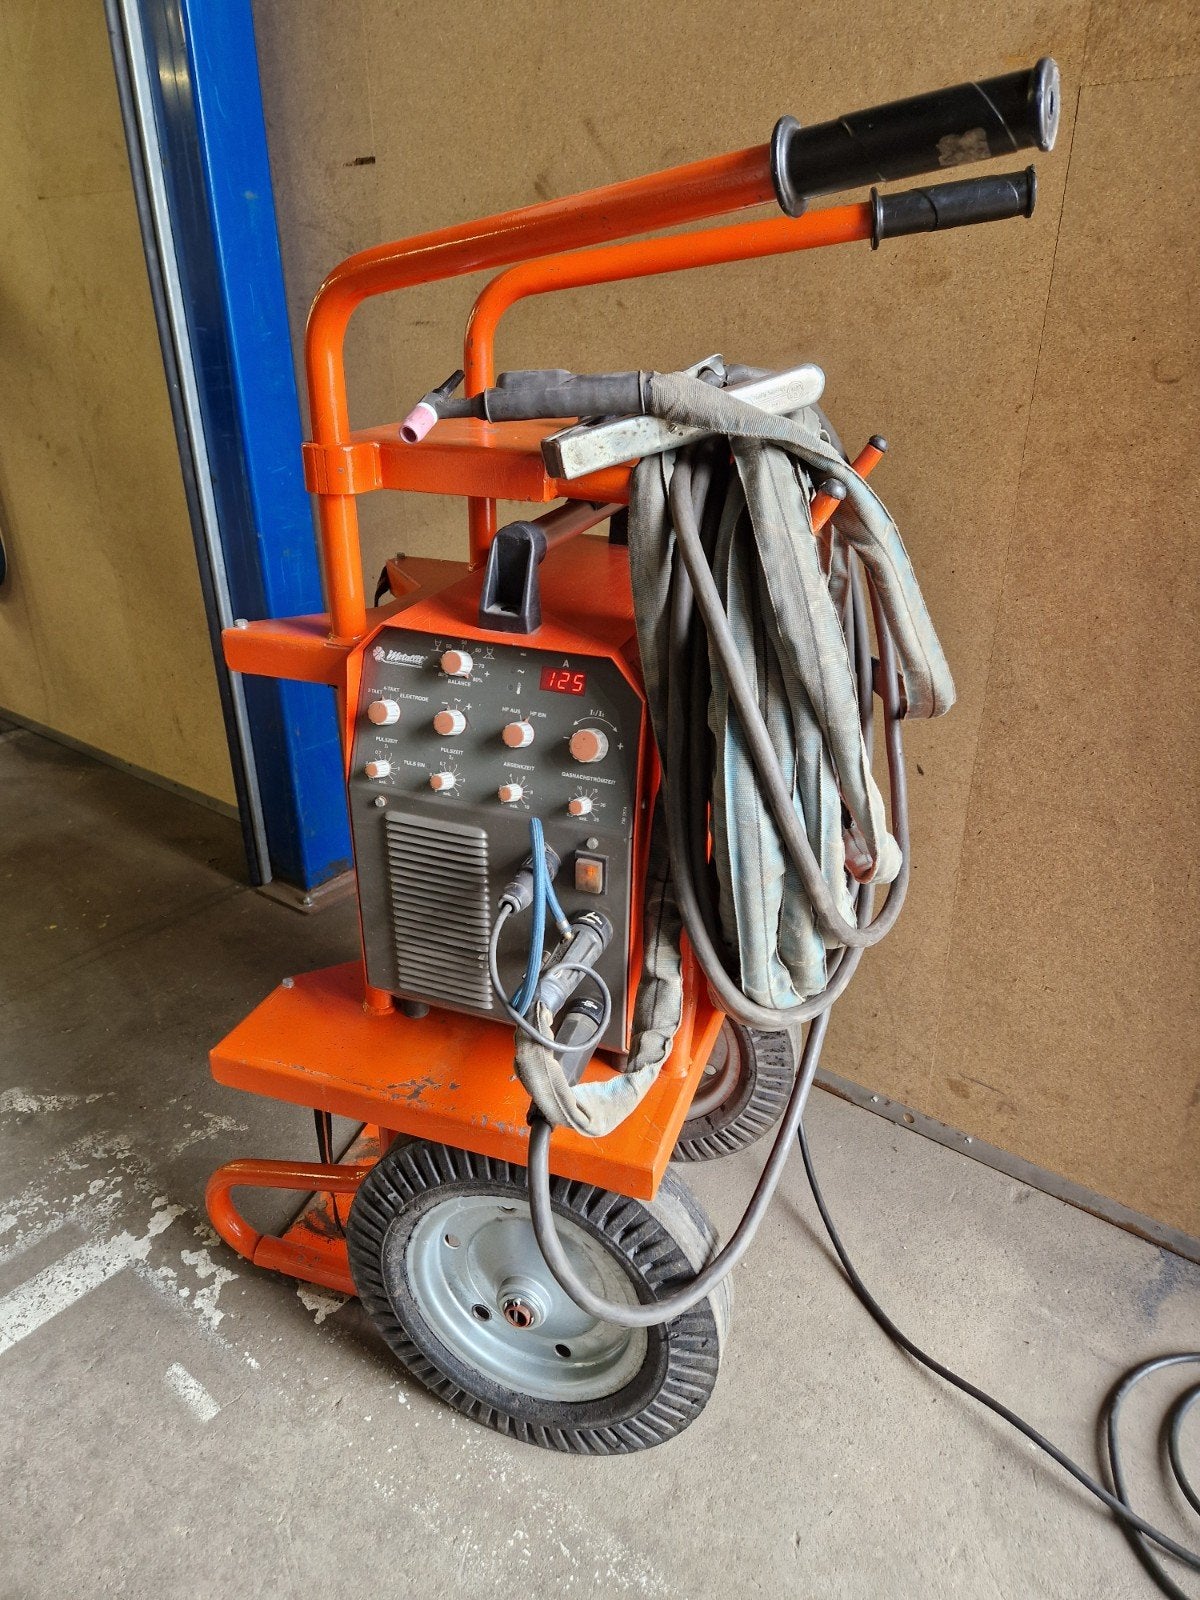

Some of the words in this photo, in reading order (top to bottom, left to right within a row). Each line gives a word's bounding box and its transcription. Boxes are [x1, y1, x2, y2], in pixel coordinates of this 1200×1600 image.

[562, 660, 570, 668] A
[447, 679, 472, 687] BALANCE
[549, 671, 584, 692] 125
[400, 693, 430, 703] ELEKTRODE
[375, 736, 399, 744] PULSZEIT
[440, 747, 464, 755] PULSZEIT
